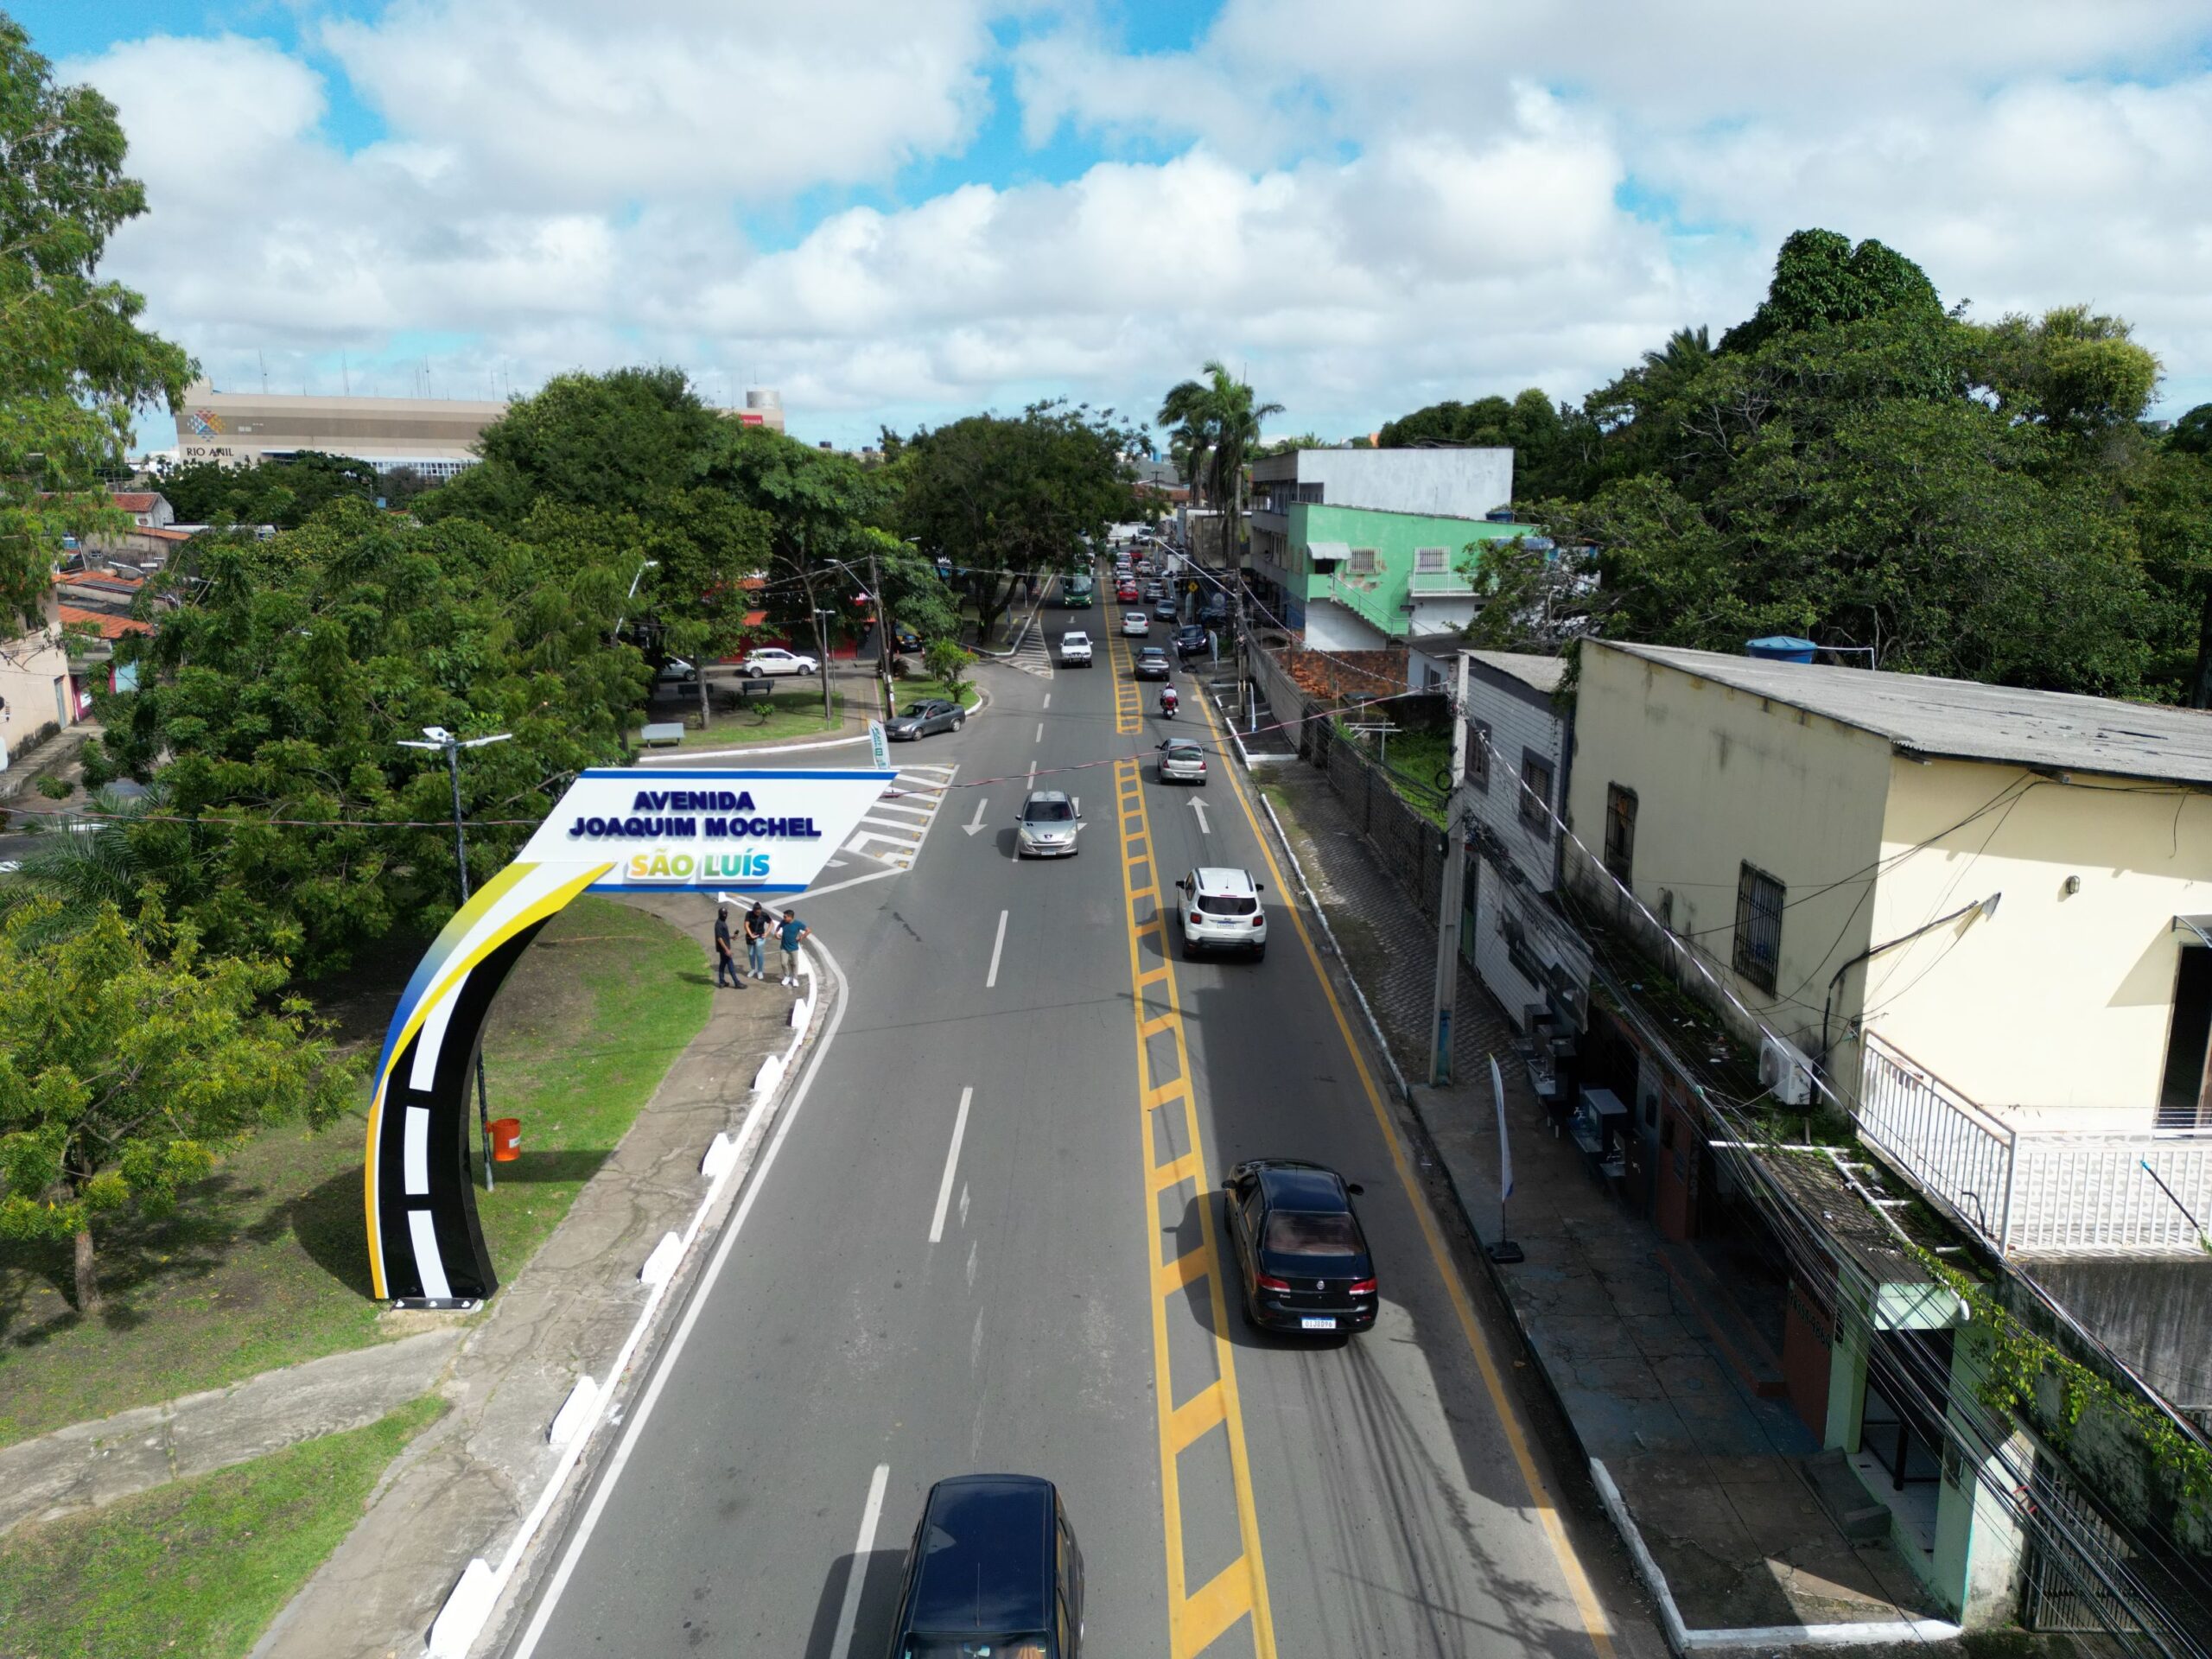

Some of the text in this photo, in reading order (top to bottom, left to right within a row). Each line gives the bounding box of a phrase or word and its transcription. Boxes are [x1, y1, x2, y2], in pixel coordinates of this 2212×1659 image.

[187, 448, 234, 457] RIO ANIL
[632, 791, 756, 810] AVENIDA
[569, 817, 822, 837] JOAQUIM MOCHEL
[630, 848, 771, 877] SÃO LUÍS
